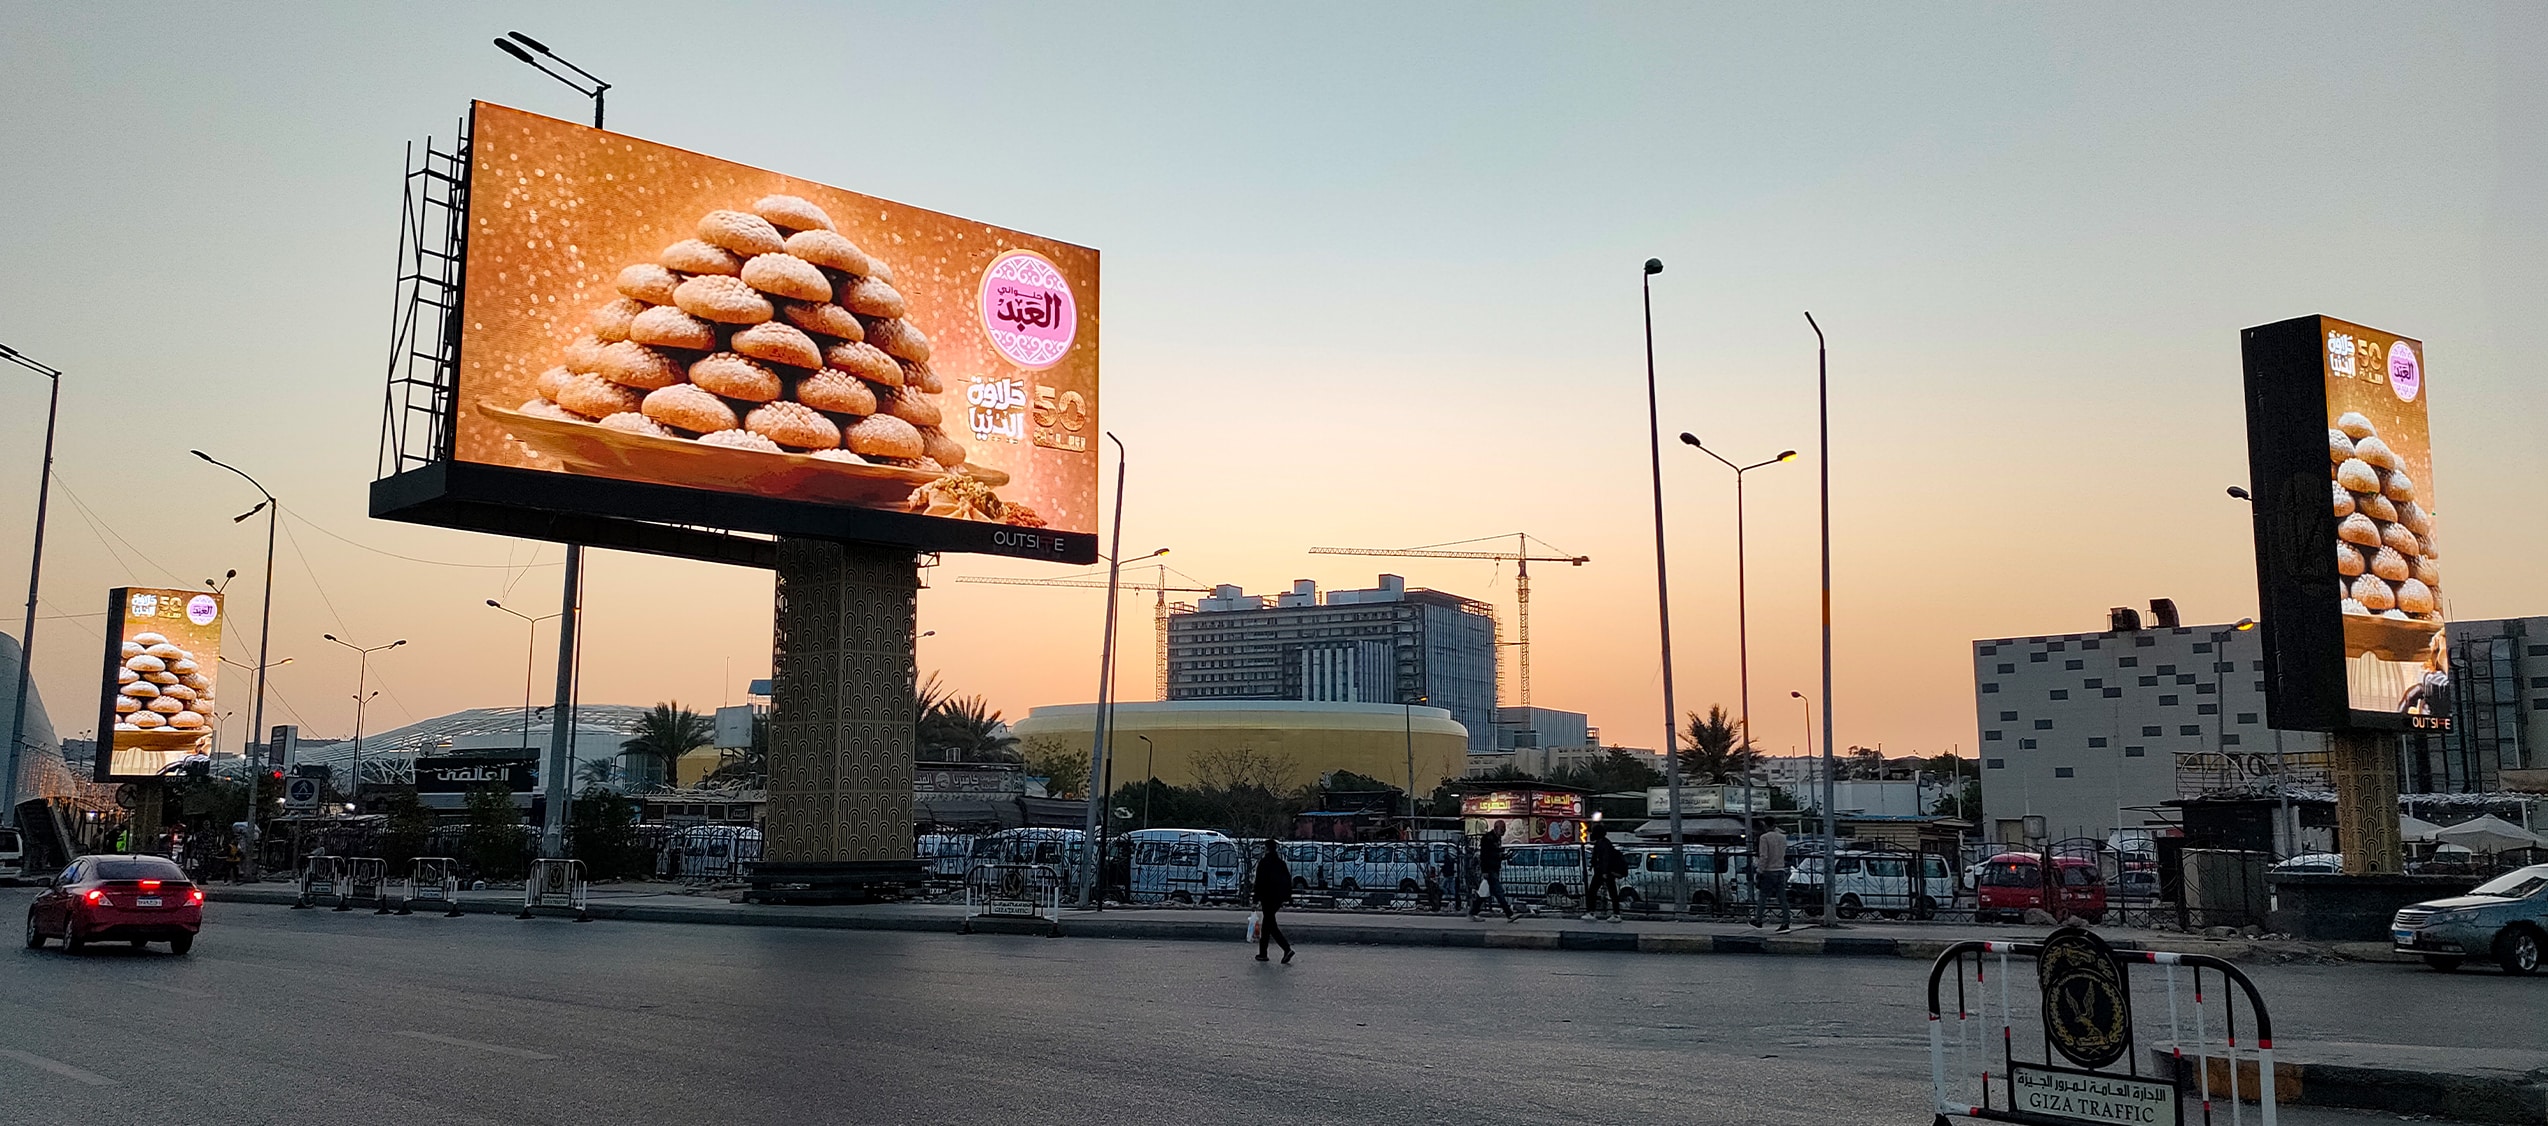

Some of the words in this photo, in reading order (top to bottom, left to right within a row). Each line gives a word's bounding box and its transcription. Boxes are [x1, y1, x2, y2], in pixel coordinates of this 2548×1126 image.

[2357, 339, 2382, 371] 50
[1032, 384, 1086, 432] 50
[158, 596, 182, 613] 50
[2017, 1072, 2053, 1090] الجيزة
[2055, 1078, 2087, 1093] لمرور
[2089, 1081, 2131, 1098] العامة
[2029, 1092, 2074, 1113] GIZA
[2078, 1099, 2155, 1123] TRAFFIC
